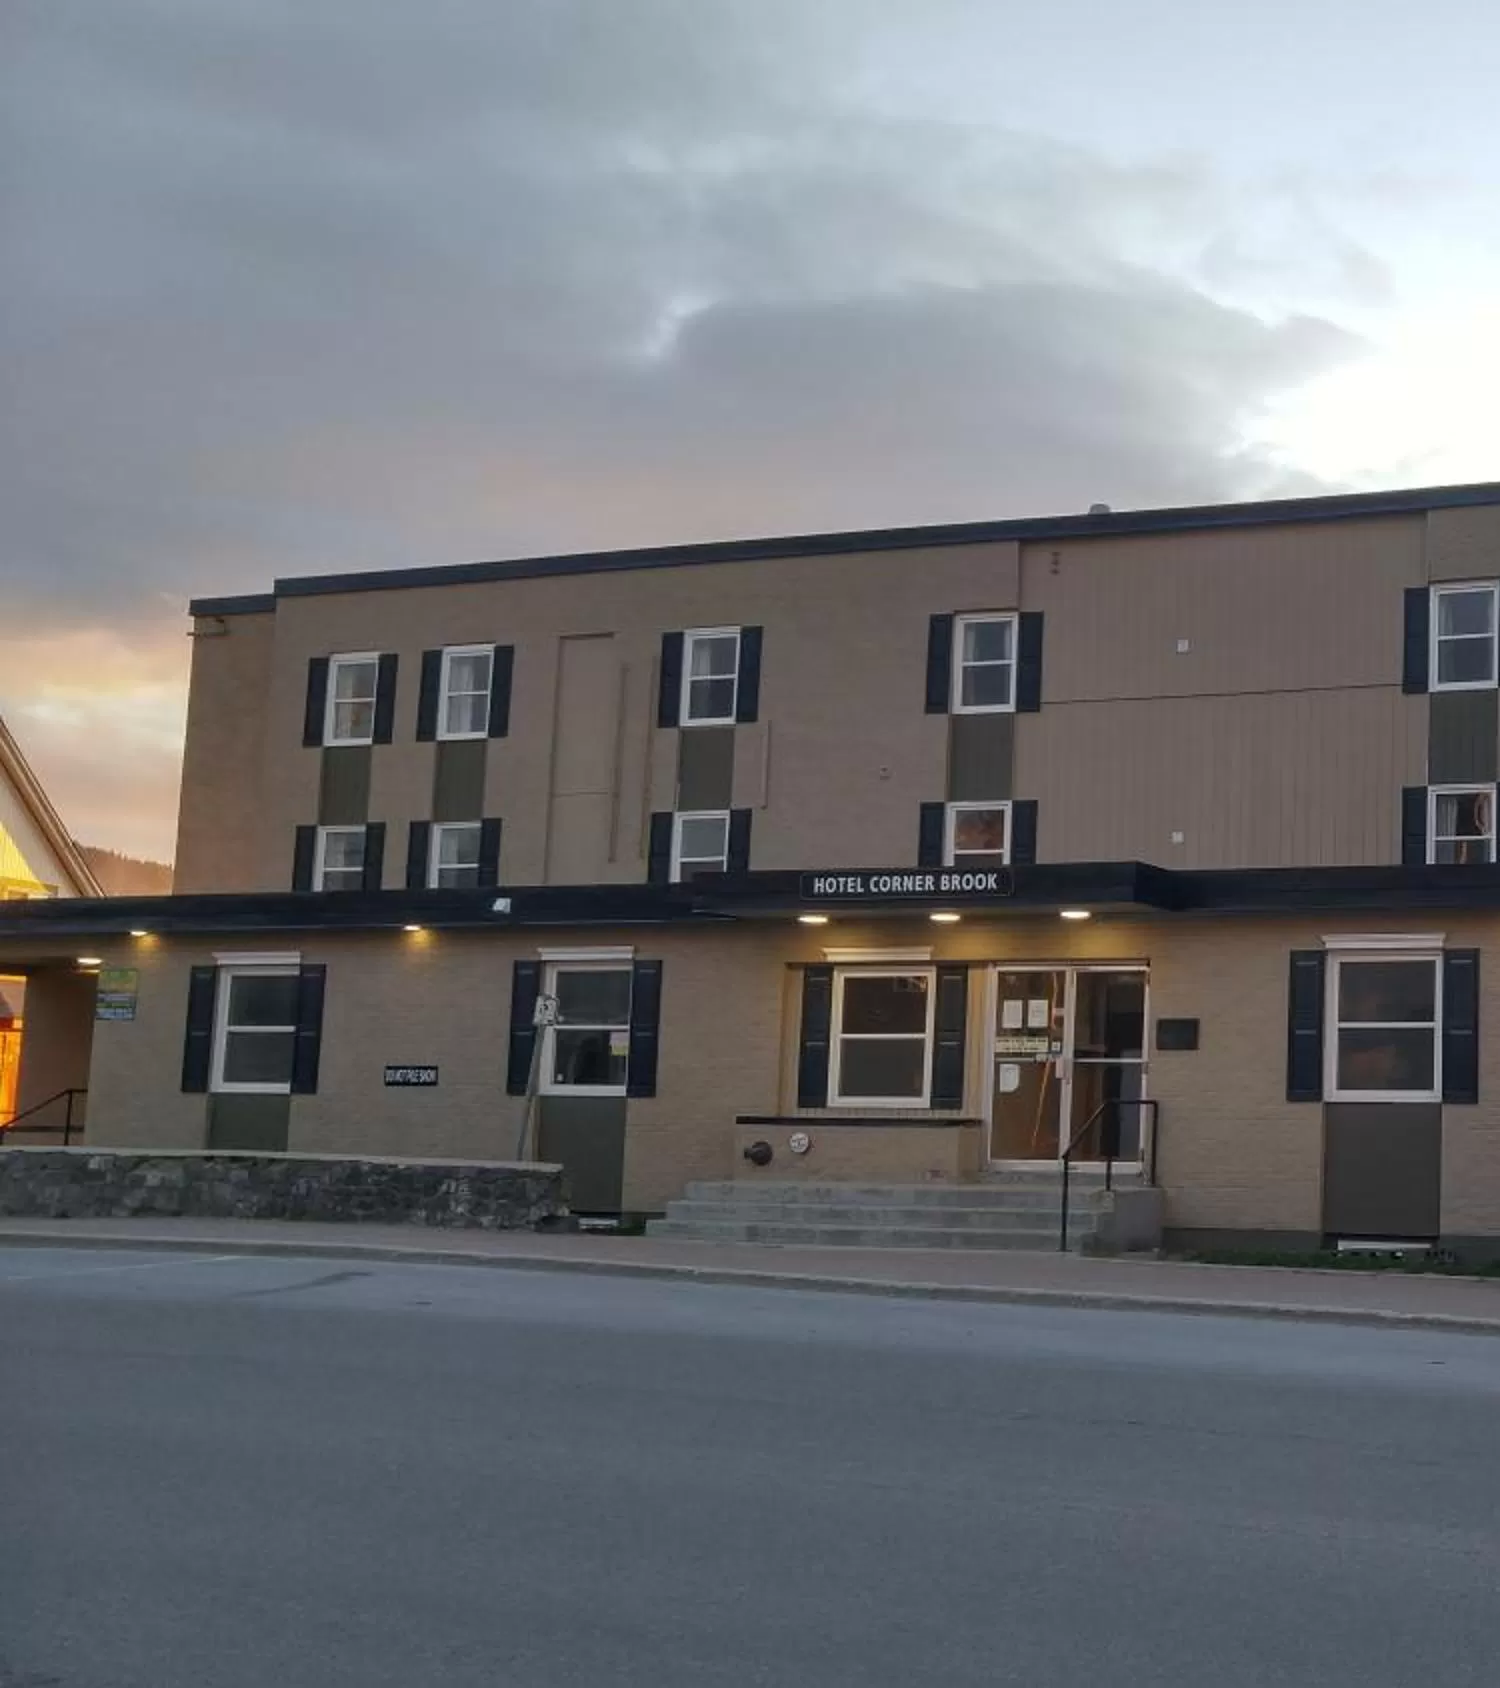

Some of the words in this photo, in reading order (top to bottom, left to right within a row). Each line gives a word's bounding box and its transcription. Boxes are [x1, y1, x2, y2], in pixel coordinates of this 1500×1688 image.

[813, 877, 865, 893] HOTEL
[869, 875, 935, 893] CORNER
[940, 873, 998, 890] BROOK
